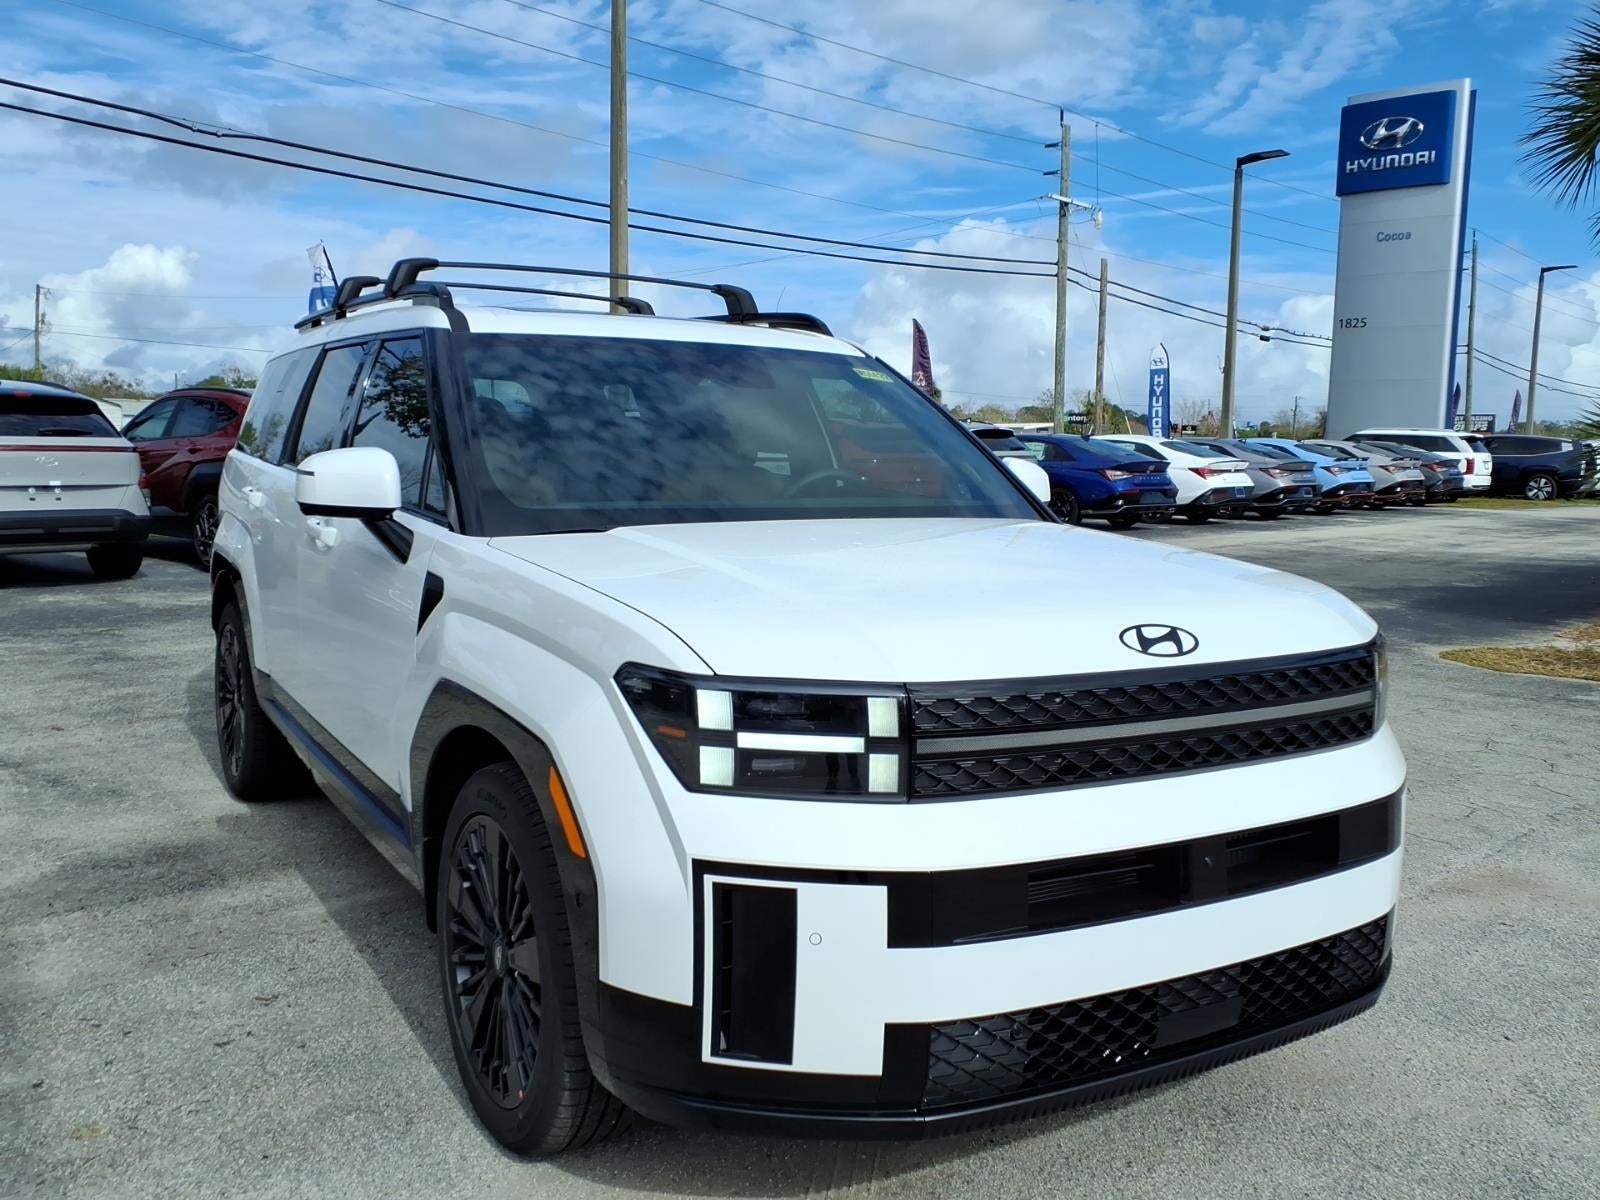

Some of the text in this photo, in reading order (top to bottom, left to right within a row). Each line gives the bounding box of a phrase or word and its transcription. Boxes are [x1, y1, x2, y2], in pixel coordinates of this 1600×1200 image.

[1345, 150, 1436, 173] HYUNDAI
[1376, 231, 1412, 242] Cocoa
[1338, 317, 1367, 329] 1825
[1152, 374, 1164, 437] HYUNDA
